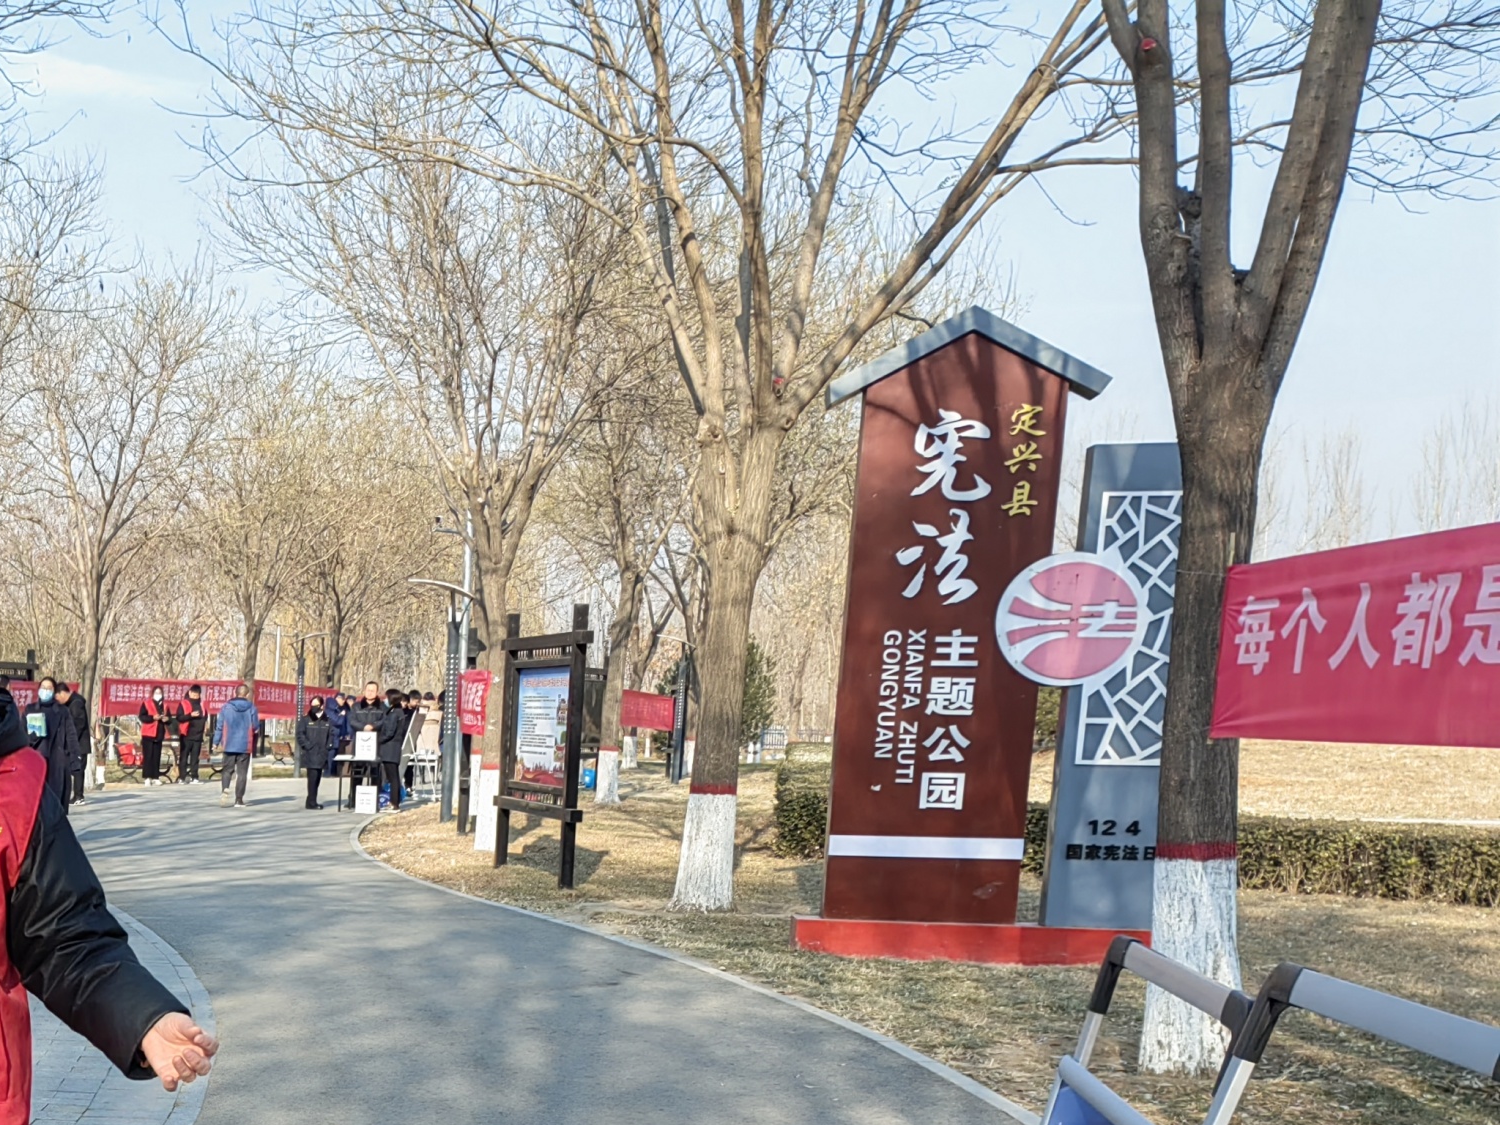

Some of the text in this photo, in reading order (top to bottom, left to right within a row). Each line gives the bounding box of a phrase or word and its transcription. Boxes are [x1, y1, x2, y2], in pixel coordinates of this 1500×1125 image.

[895, 408, 992, 606] 宪法
[1001, 403, 1047, 516] 定兴县
[1234, 564, 1500, 676] 每个人都是
[874, 629, 902, 758] GONGYUAN
[895, 628, 927, 784] XIANFA ZHUTI
[919, 628, 978, 810] 主题公园
[1065, 844, 1156, 861] 国家宪法日
[1088, 819, 1141, 836] 12 4
